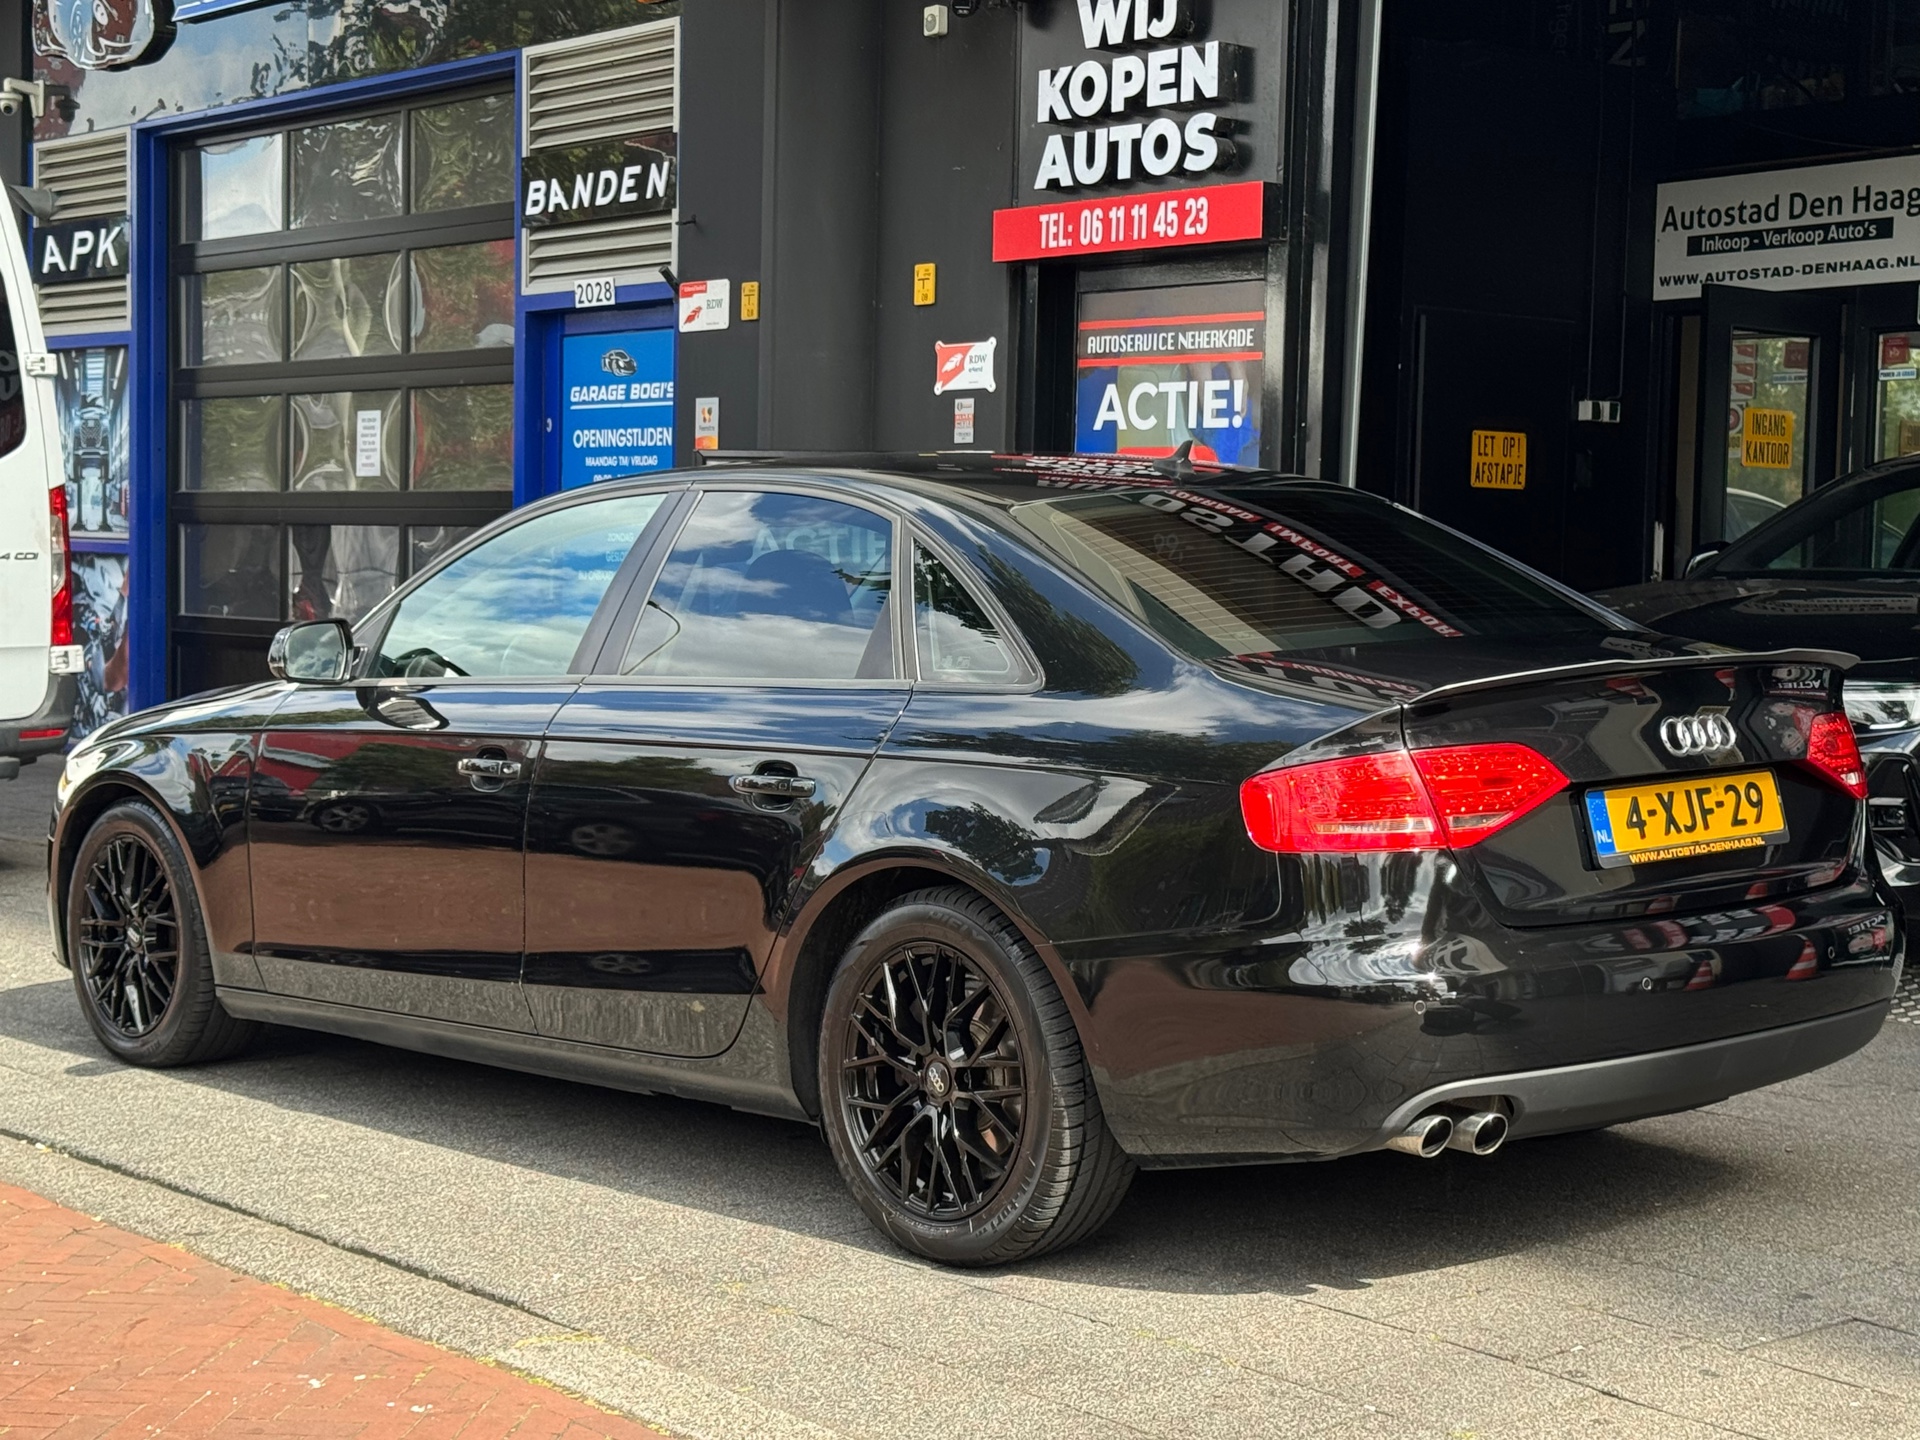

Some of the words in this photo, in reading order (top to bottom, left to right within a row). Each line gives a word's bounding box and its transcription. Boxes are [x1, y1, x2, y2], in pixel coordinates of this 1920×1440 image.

[1076, 0, 1178, 49] WIJ
[1037, 40, 1220, 124] KOPEN
[1033, 112, 1219, 190] AUTOS
[524, 160, 670, 216] BANDEN
[1660, 194, 1780, 233] Autostad
[1788, 192, 1843, 221] Den
[1852, 185, 1920, 217] Haag
[1038, 212, 1074, 250] TEL:
[1079, 207, 1104, 246] 06
[1108, 205, 1126, 243] 11
[1131, 203, 1148, 241] 11
[1153, 200, 1179, 238] 45
[1184, 196, 1209, 236] 23
[41, 226, 123, 274] APK
[1701, 236, 1750, 252] Inkoop
[1762, 227, 1824, 248] Verkoop
[1827, 222, 1877, 241] Auto's
[1659, 255, 1920, 287] WWW.AUTOSTAD-DENHAAG.NL
[577, 278, 612, 304] 2028
[706, 298, 724, 310] RDW
[1087, 331, 1176, 355] AUTOSERVICE
[1178, 328, 1255, 350] NEHERKADE
[968, 354, 988, 364] RDW
[570, 384, 627, 402] GARAGE
[629, 381, 674, 400] BOGI'S
[1092, 379, 1244, 431] ACTIE!
[1752, 412, 1786, 437] INGANG
[572, 427, 672, 449] OPENINGSTIJDEN
[1477, 435, 1496, 457] LET
[1502, 436, 1521, 458] OP!
[585, 456, 618, 467] MAANDAG
[631, 455, 658, 466] VRIJDAG
[1745, 441, 1790, 465] KANTOOR
[1474, 462, 1523, 486] AFSTAPJE
[14, 552, 39, 560] CDI
[605, 550, 627, 563] GESLO
[1625, 781, 1764, 840] 4-XJF-29
[1597, 830, 1612, 844] NL
[1629, 836, 1766, 864] WWW.AUTOSTAD-DENHAAG.NL
